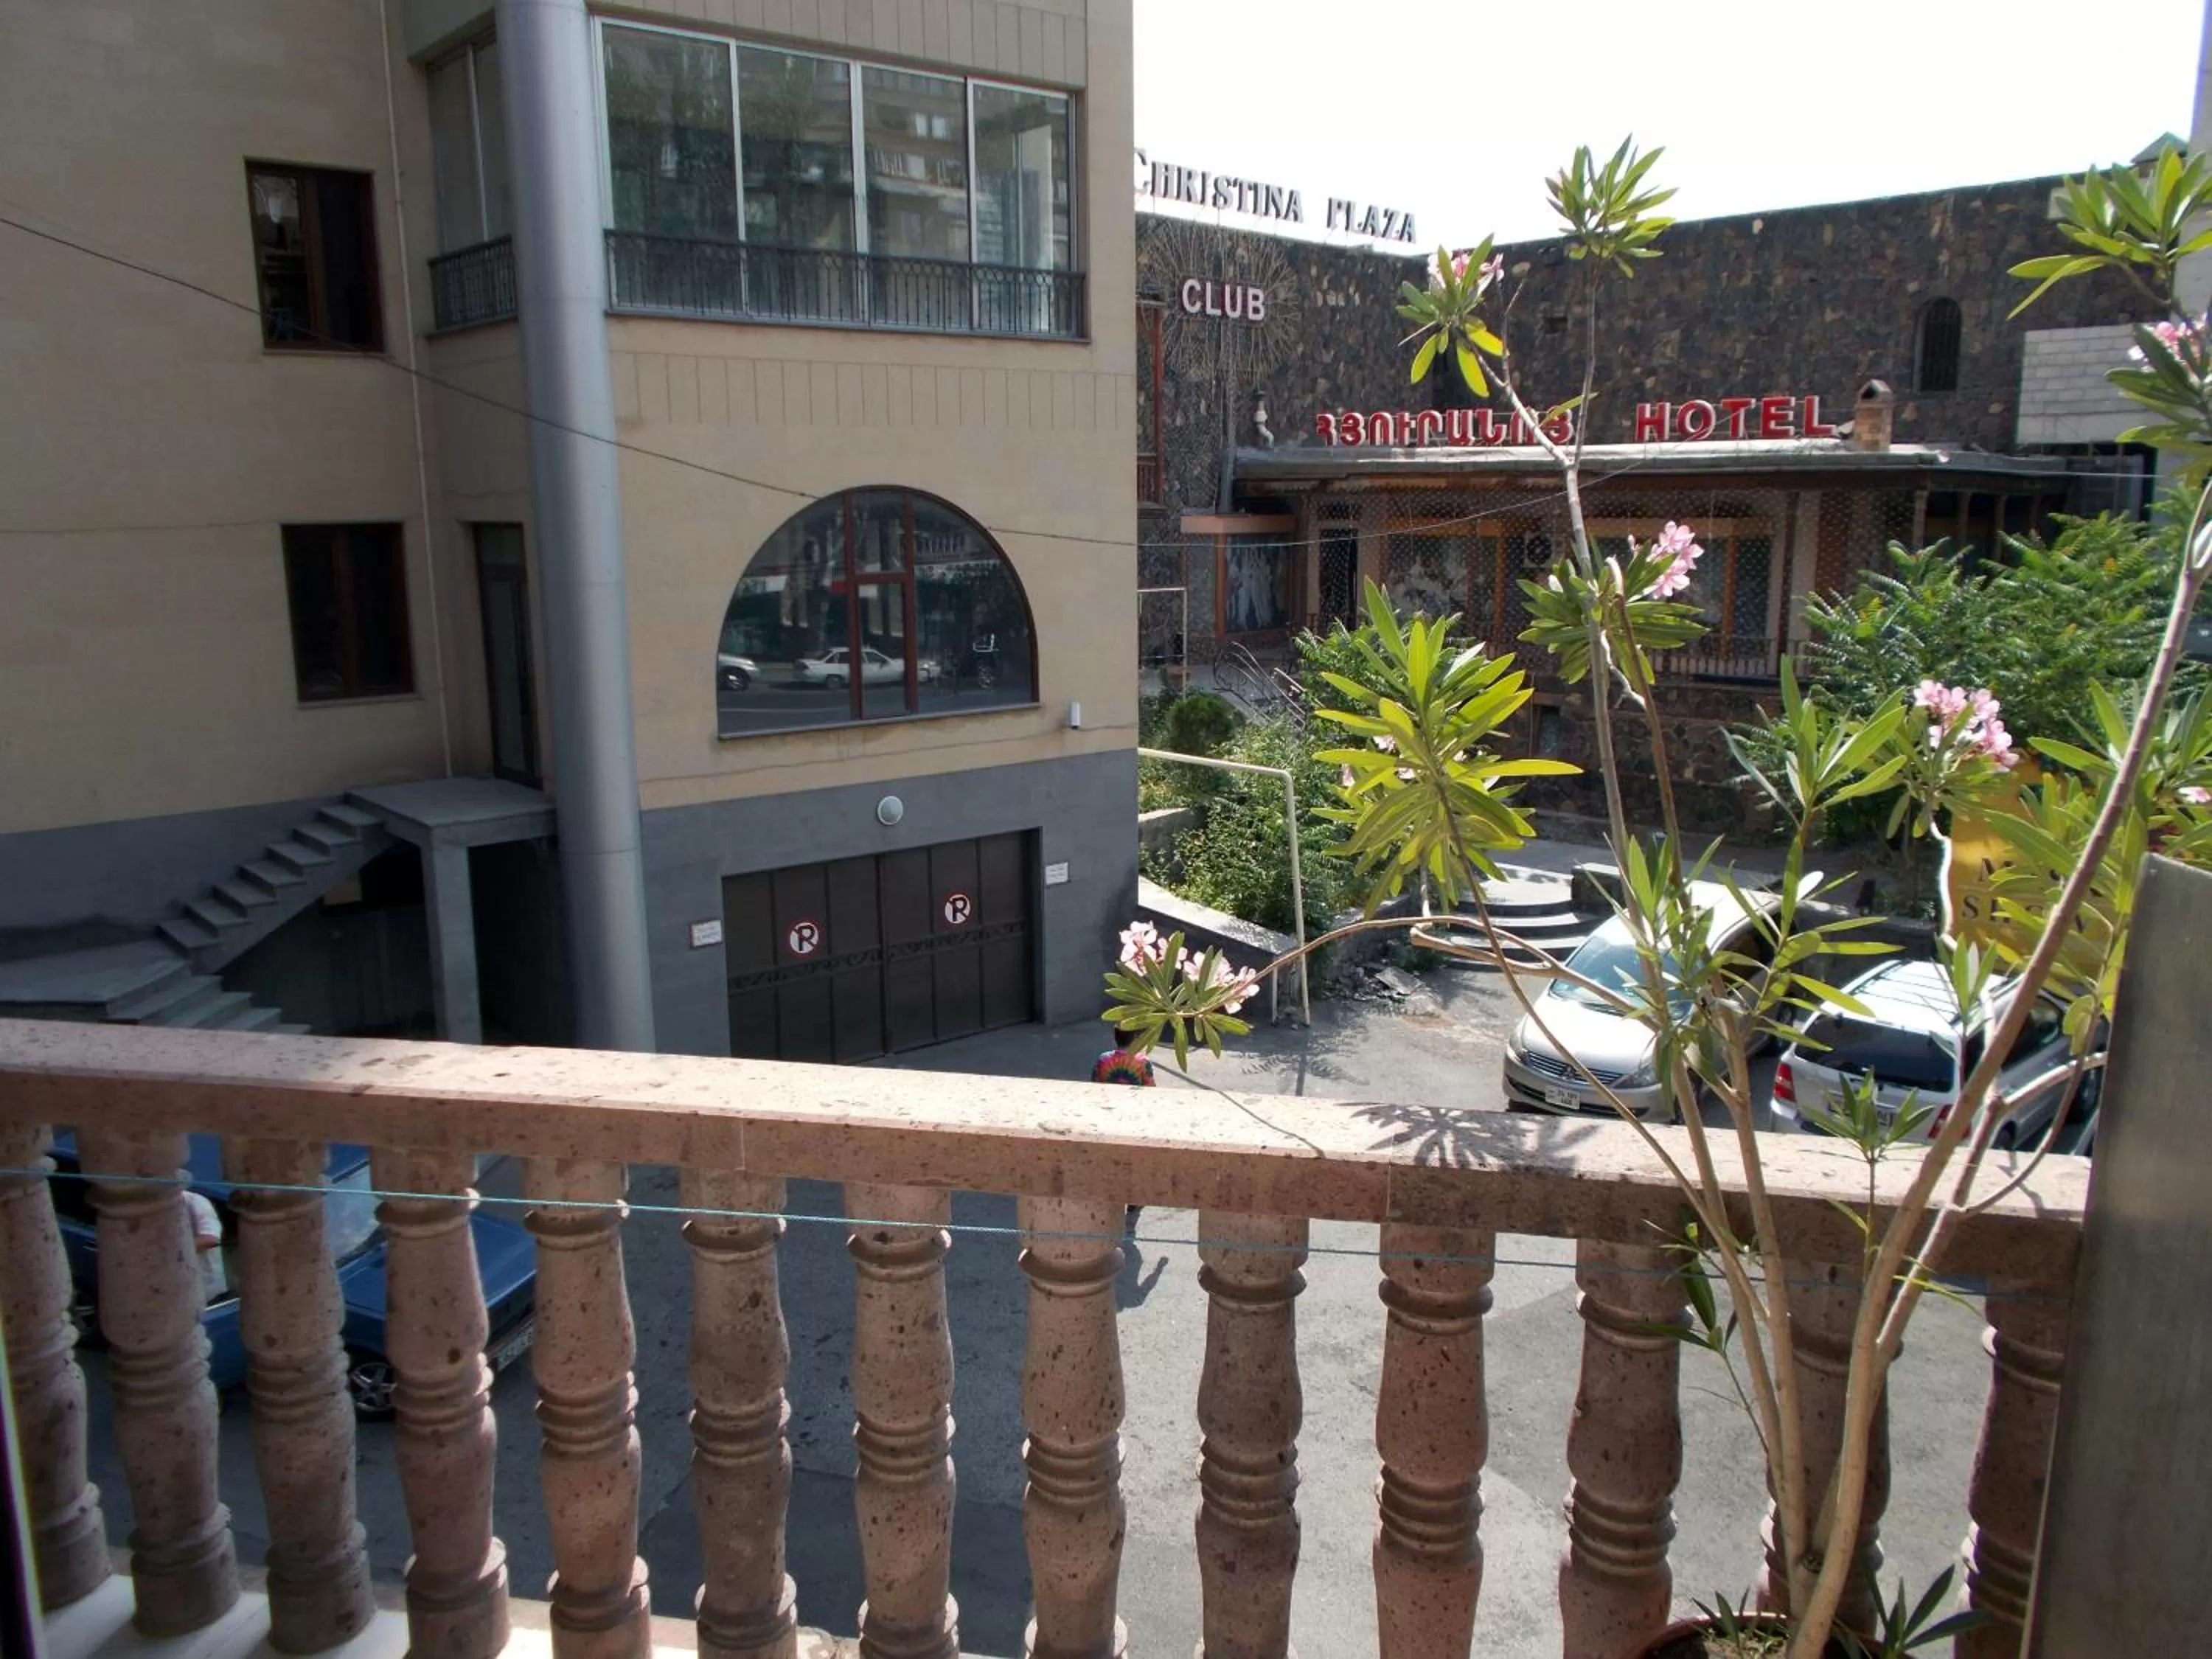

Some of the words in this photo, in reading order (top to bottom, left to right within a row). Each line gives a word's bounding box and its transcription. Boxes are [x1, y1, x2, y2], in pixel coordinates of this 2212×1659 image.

[1134, 147, 1303, 223] CHRISTINA
[1326, 197, 1416, 243] PLAZA
[1182, 278, 1266, 321] CLUB
[1635, 395, 1837, 442] HOTEL
